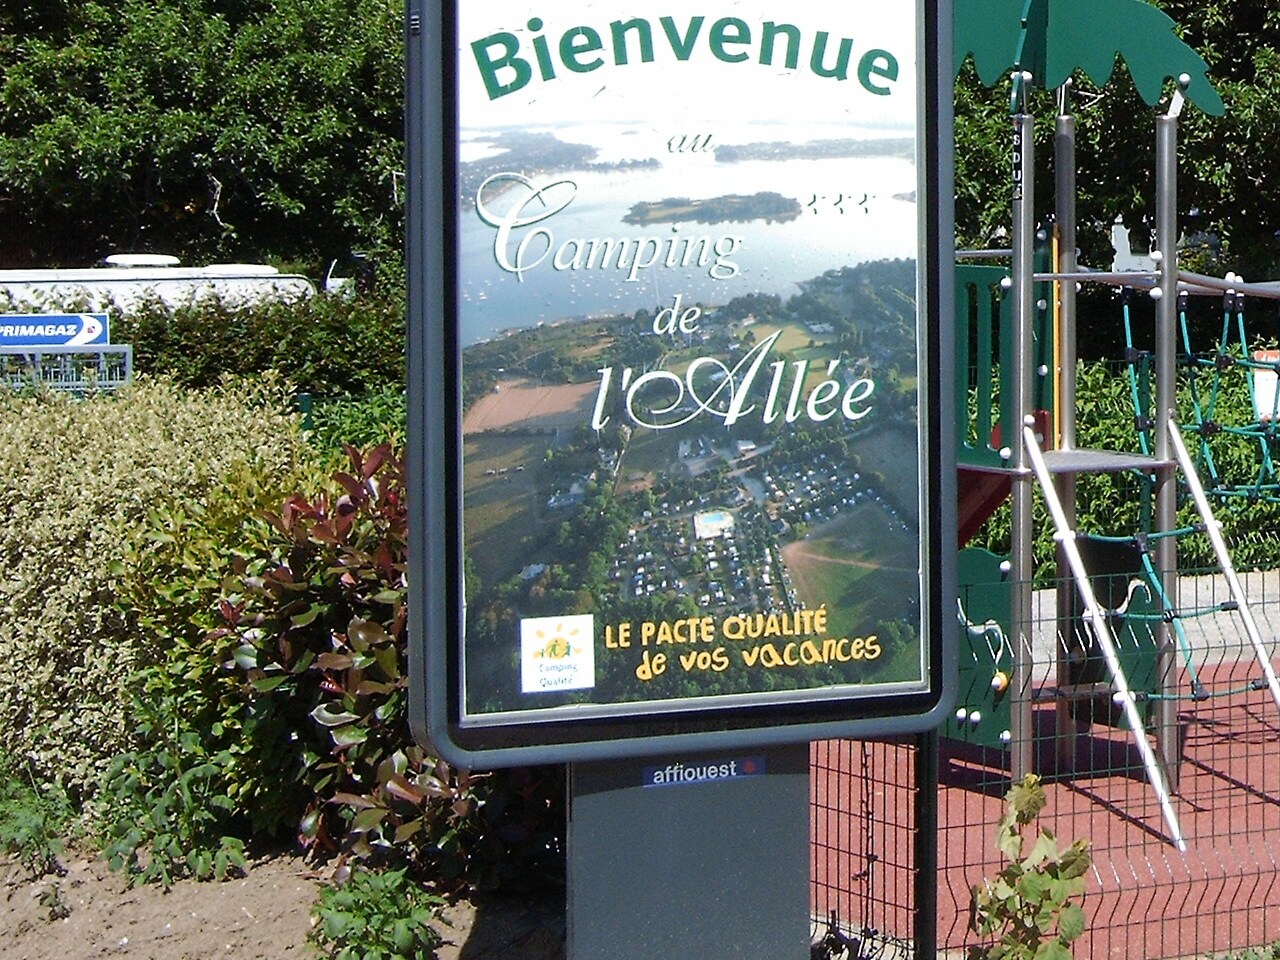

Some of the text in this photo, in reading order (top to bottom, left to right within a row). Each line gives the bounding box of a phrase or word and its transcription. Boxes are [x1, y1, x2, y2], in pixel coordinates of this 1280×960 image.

[471, 15, 900, 100] Bienvenue
[667, 133, 714, 153] au
[475, 171, 745, 282] Camping
[653, 294, 702, 334] de
[591, 329, 876, 431] l'Allée
[605, 604, 828, 649] LE PACTE QUALITÉ
[635, 635, 882, 681] de vos vacances
[653, 760, 737, 784] affiouest
